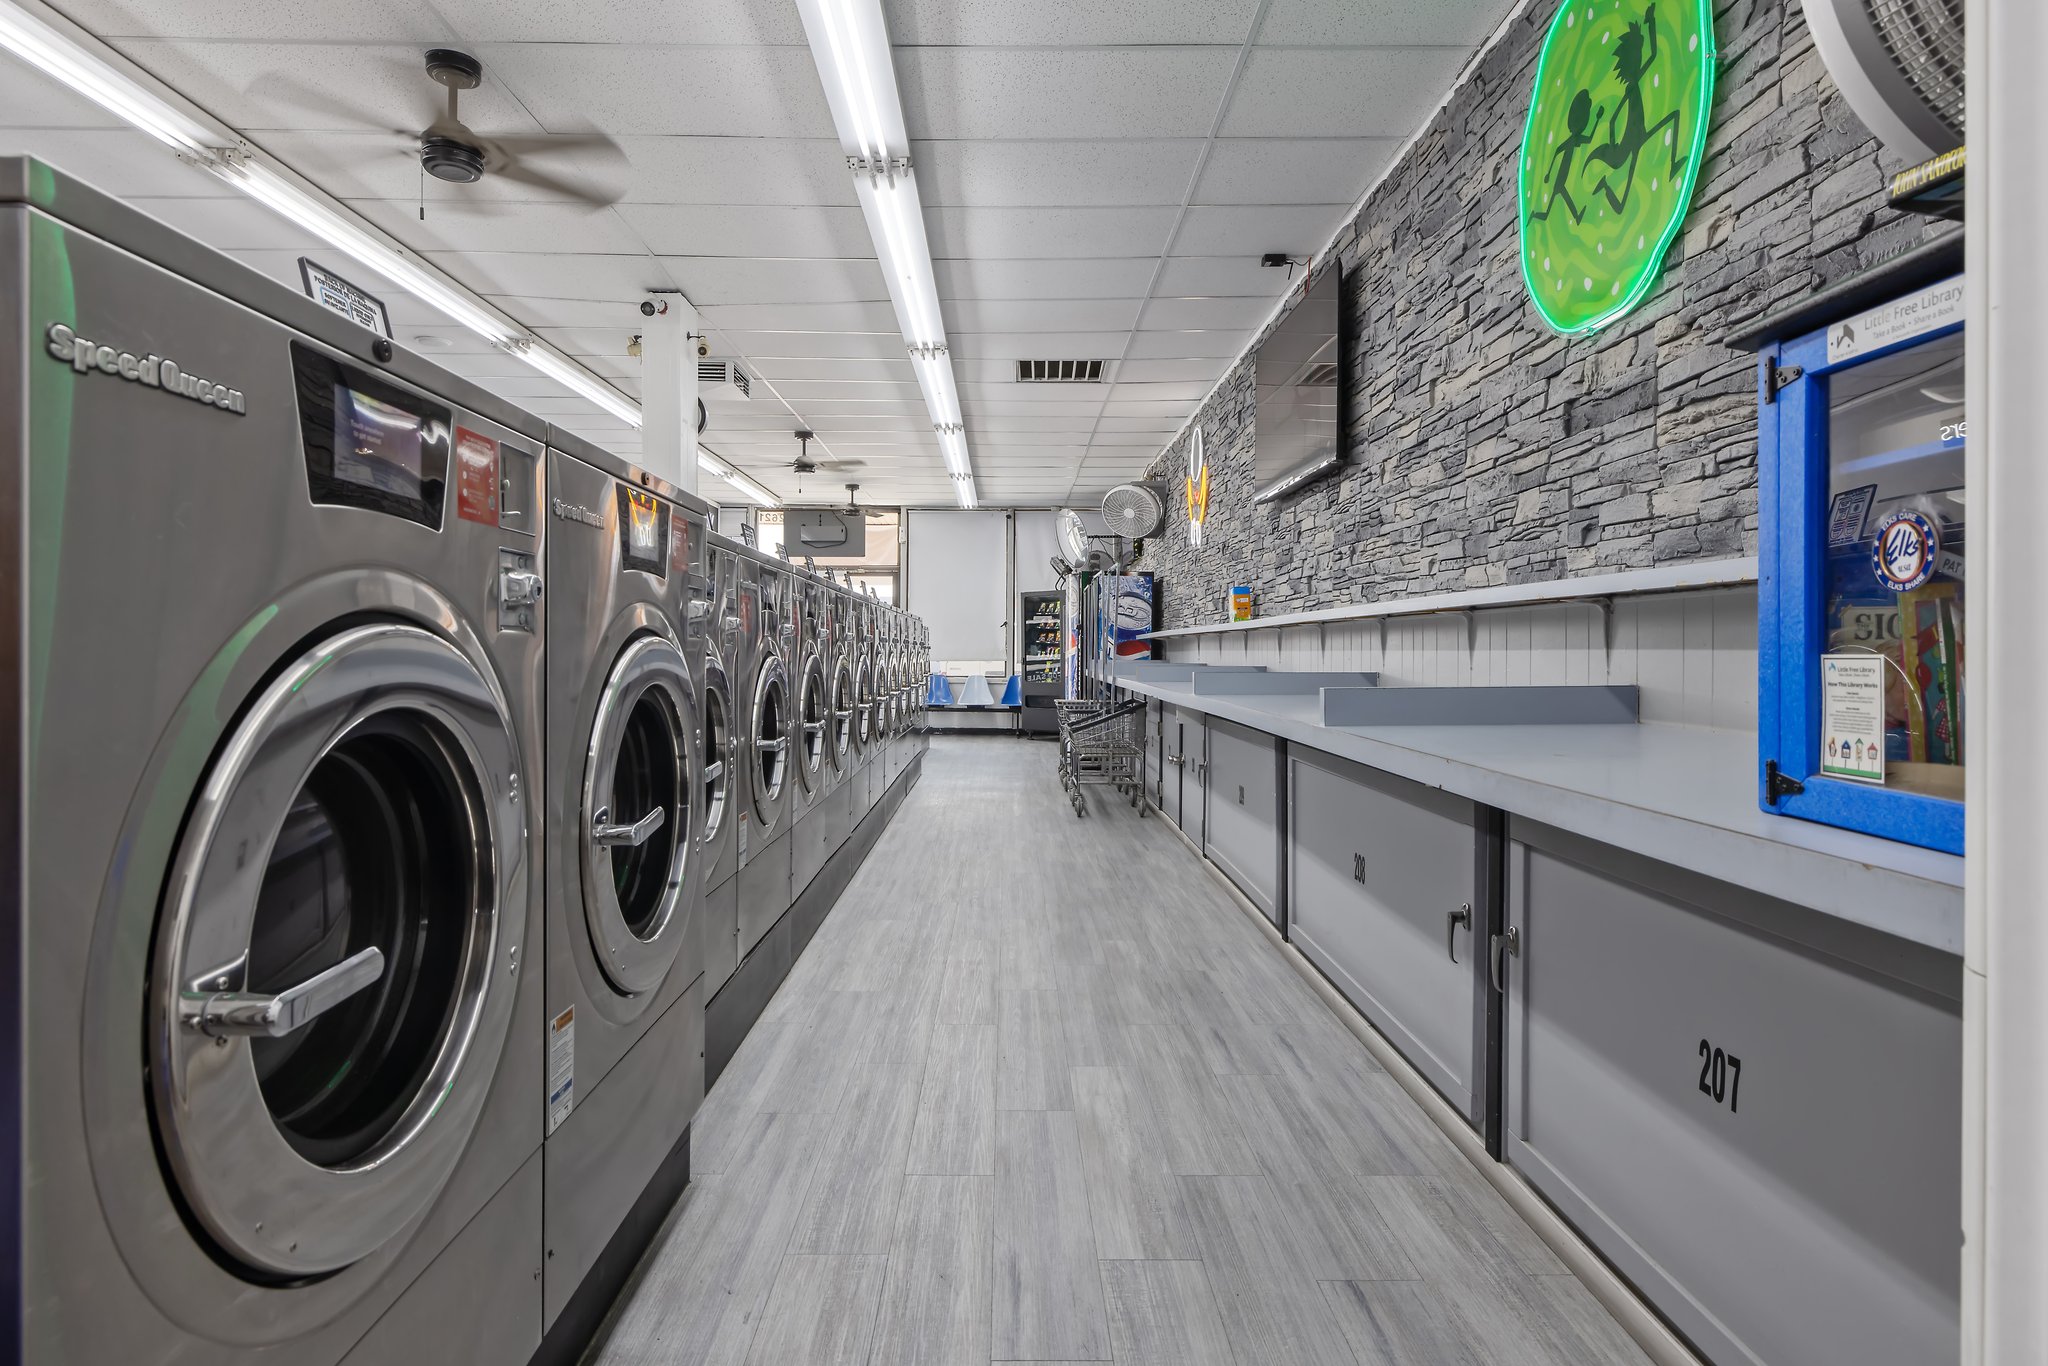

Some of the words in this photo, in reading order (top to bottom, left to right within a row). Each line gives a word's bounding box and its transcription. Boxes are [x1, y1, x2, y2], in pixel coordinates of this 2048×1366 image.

[1893, 166, 1919, 198] JOHN
[1864, 310, 1891, 331] Little
[1894, 301, 1918, 319] Free
[1921, 284, 1964, 310] Library
[1873, 330, 1885, 339] Take
[1891, 322, 1906, 334] Book
[1913, 314, 1932, 326] Share
[1938, 304, 1955, 317] Book
[46, 322, 160, 387] Speed
[159, 359, 246, 416] Queen
[1887, 528, 1919, 566] Elks
[1888, 581, 1904, 591] ELKS
[1905, 573, 1926, 590] SHARE
[1942, 558, 1962, 573] PAT
[1699, 1038, 1741, 1114] 207
